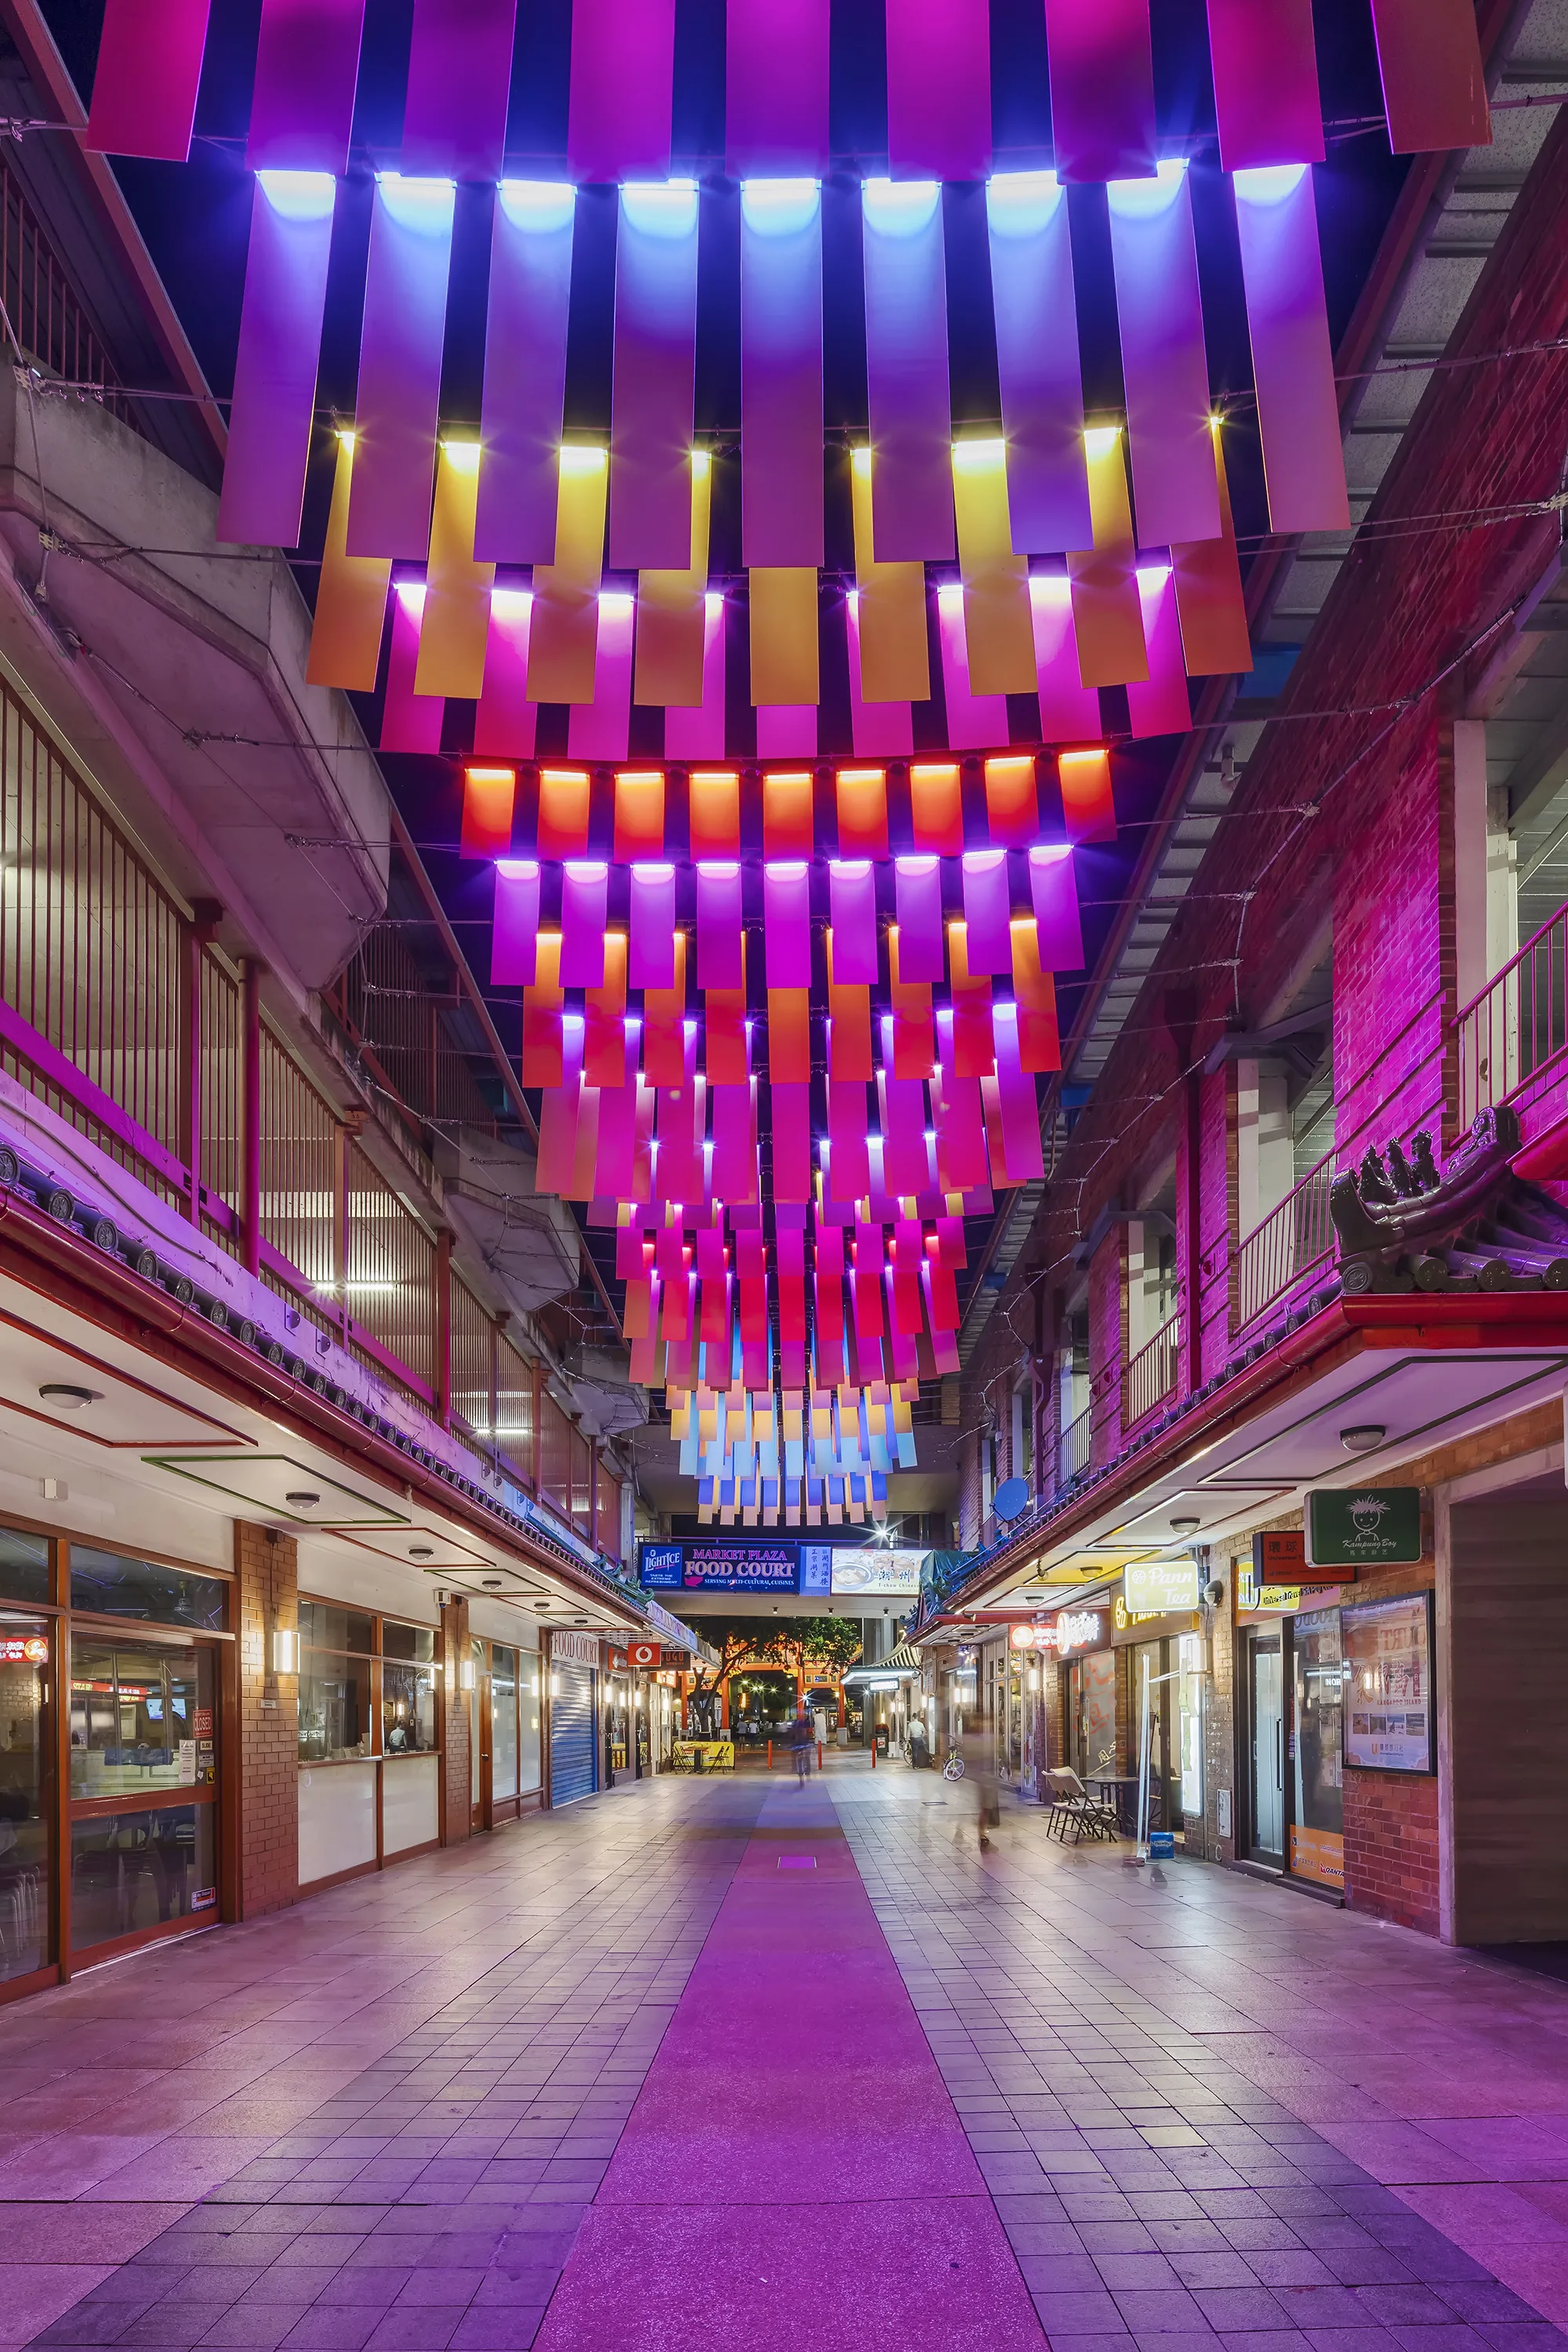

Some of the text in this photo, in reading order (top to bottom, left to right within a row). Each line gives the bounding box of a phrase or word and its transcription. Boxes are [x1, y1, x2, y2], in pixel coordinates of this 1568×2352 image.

[1342, 1538, 1397, 1548] Kampung Boy
[692, 1548, 788, 1560] MARKET PLAZA
[684, 1561, 796, 1577] FOOD COURT
[1148, 1567, 1193, 1587] Pann
[1162, 1587, 1192, 1606] Tea
[554, 1631, 575, 1658] FOOD
[575, 1635, 597, 1663] COURT
[194, 1716, 212, 1732] CLOSED
[1325, 1867, 1345, 1878] QANTA
